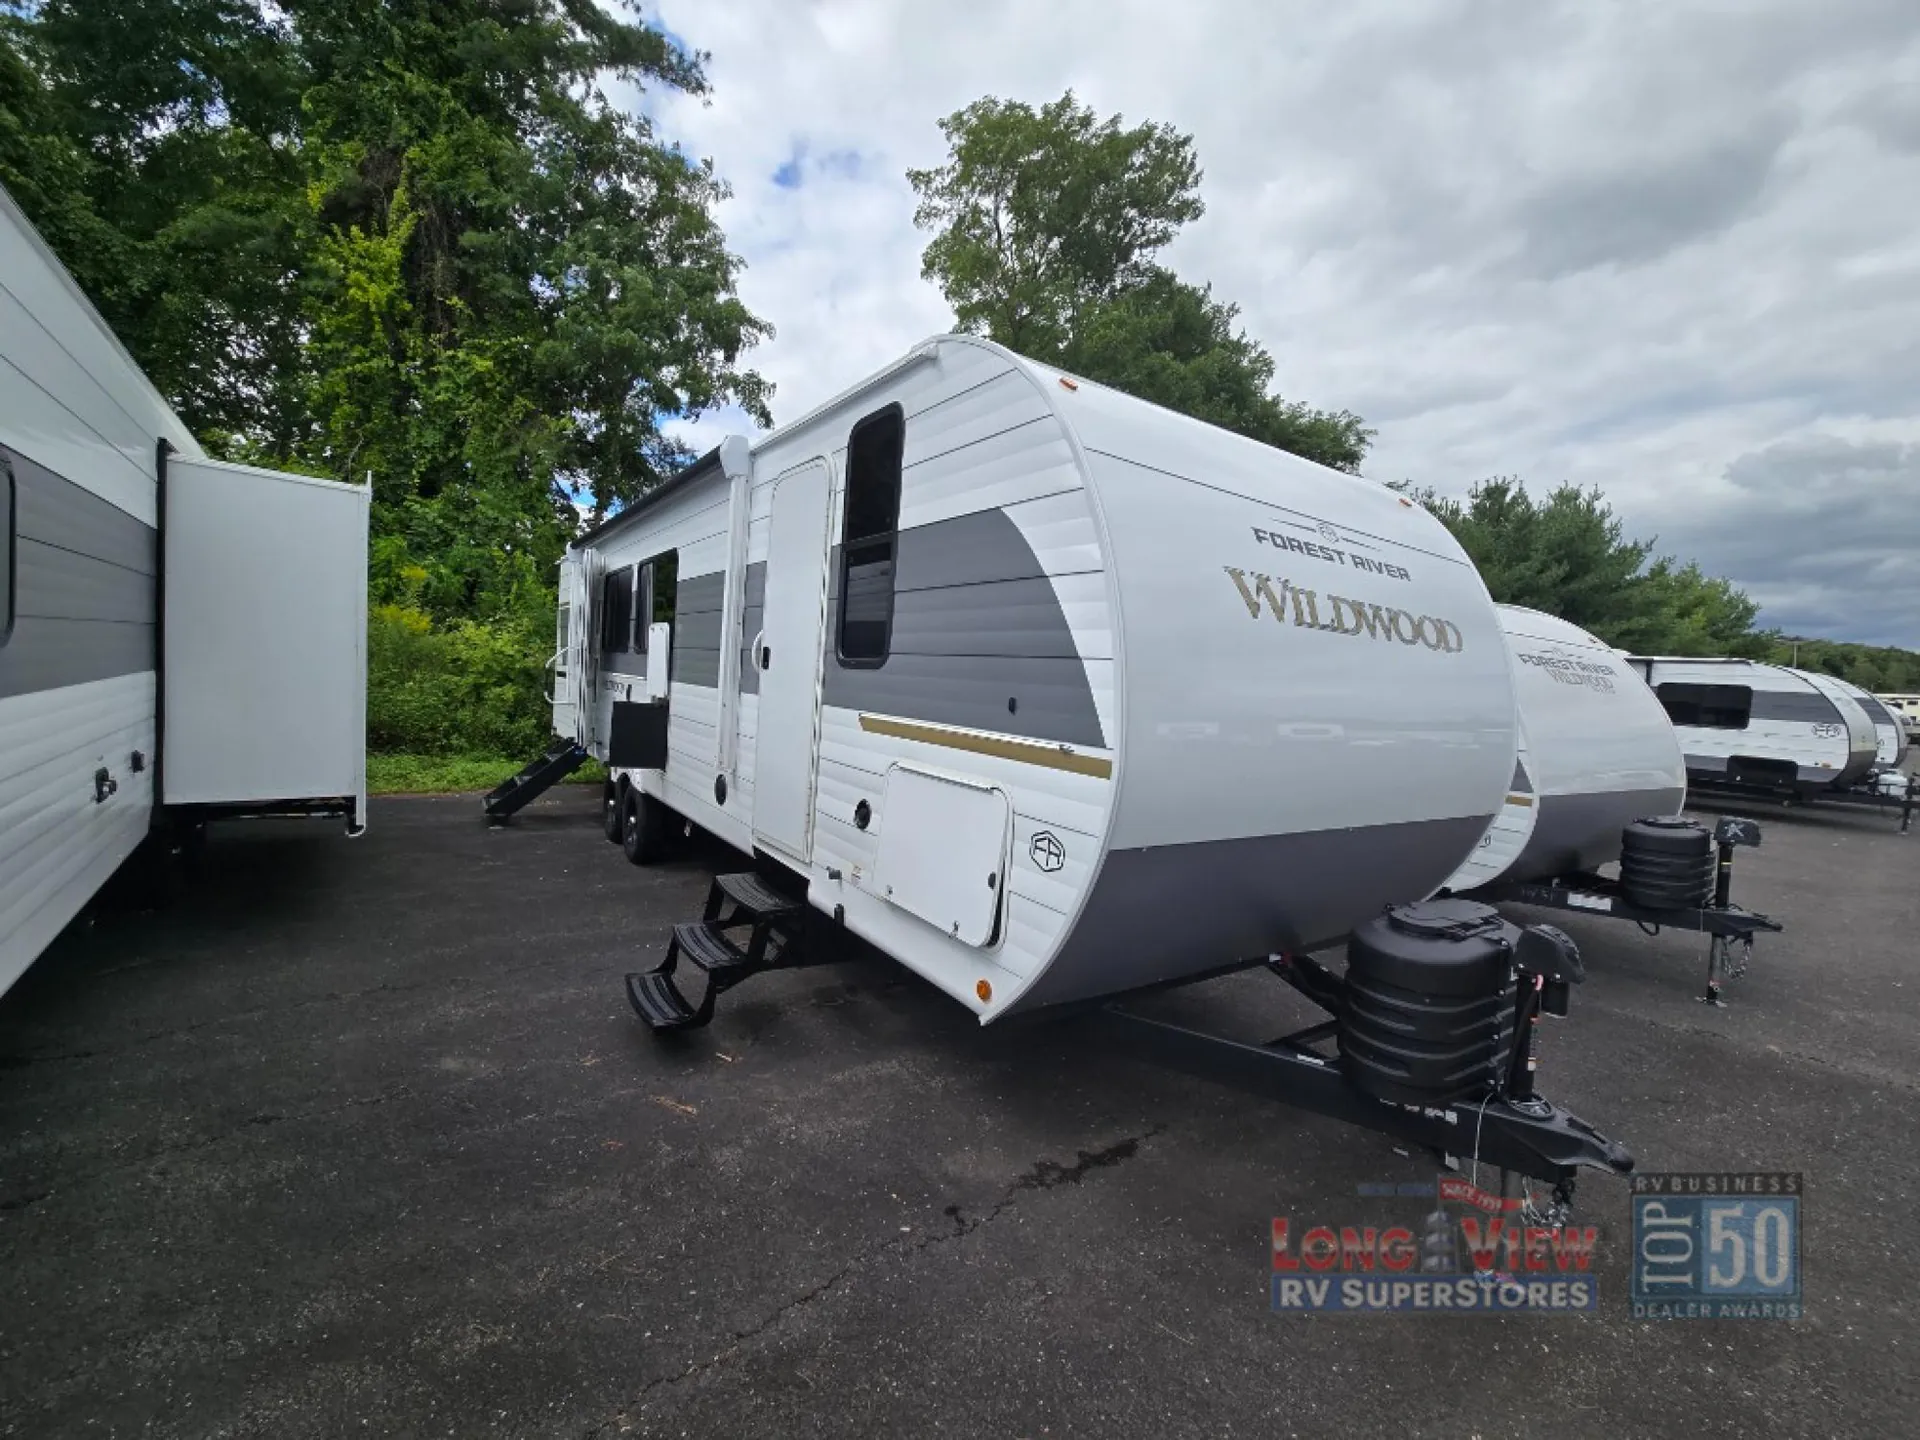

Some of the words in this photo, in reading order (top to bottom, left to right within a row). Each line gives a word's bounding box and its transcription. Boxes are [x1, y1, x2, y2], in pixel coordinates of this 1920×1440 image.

[1251, 526, 1345, 565] FOREST
[1349, 553, 1411, 581] RIVER
[1223, 565, 1463, 653] WILDWOOD
[1518, 653, 1576, 671] FOREST
